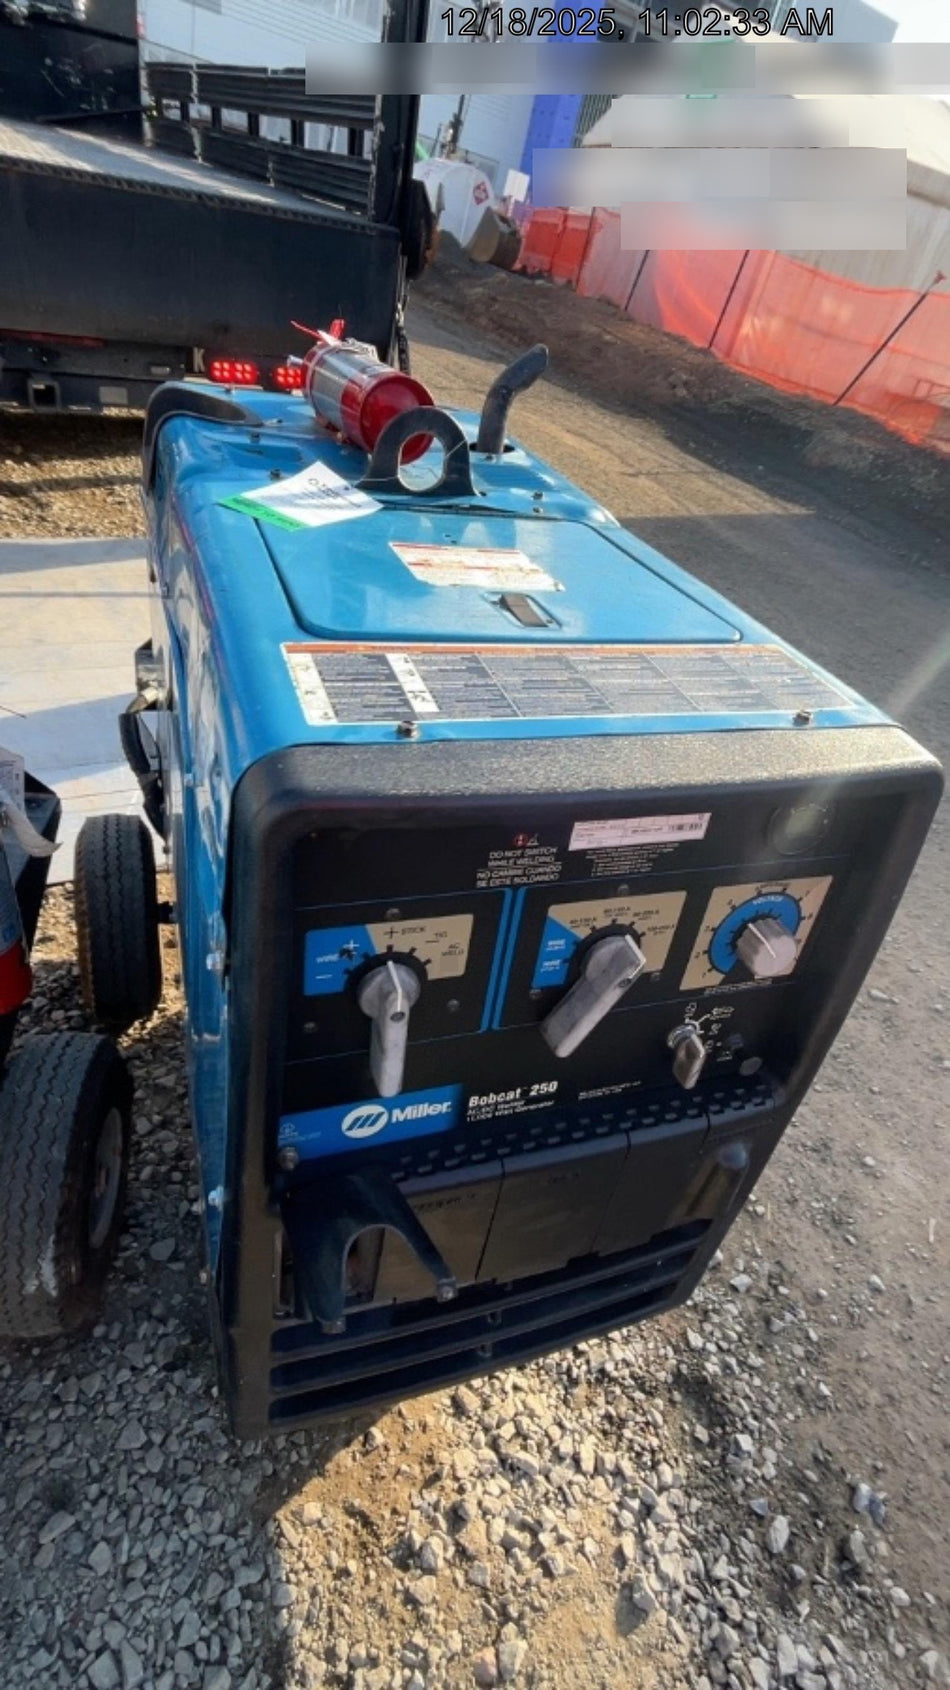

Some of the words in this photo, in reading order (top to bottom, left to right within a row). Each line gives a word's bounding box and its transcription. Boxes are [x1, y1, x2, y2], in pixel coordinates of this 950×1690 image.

[469, 1088, 522, 1108] Bobcat
[529, 1081, 559, 1096] 250
[391, 1101, 452, 1123] Miller
